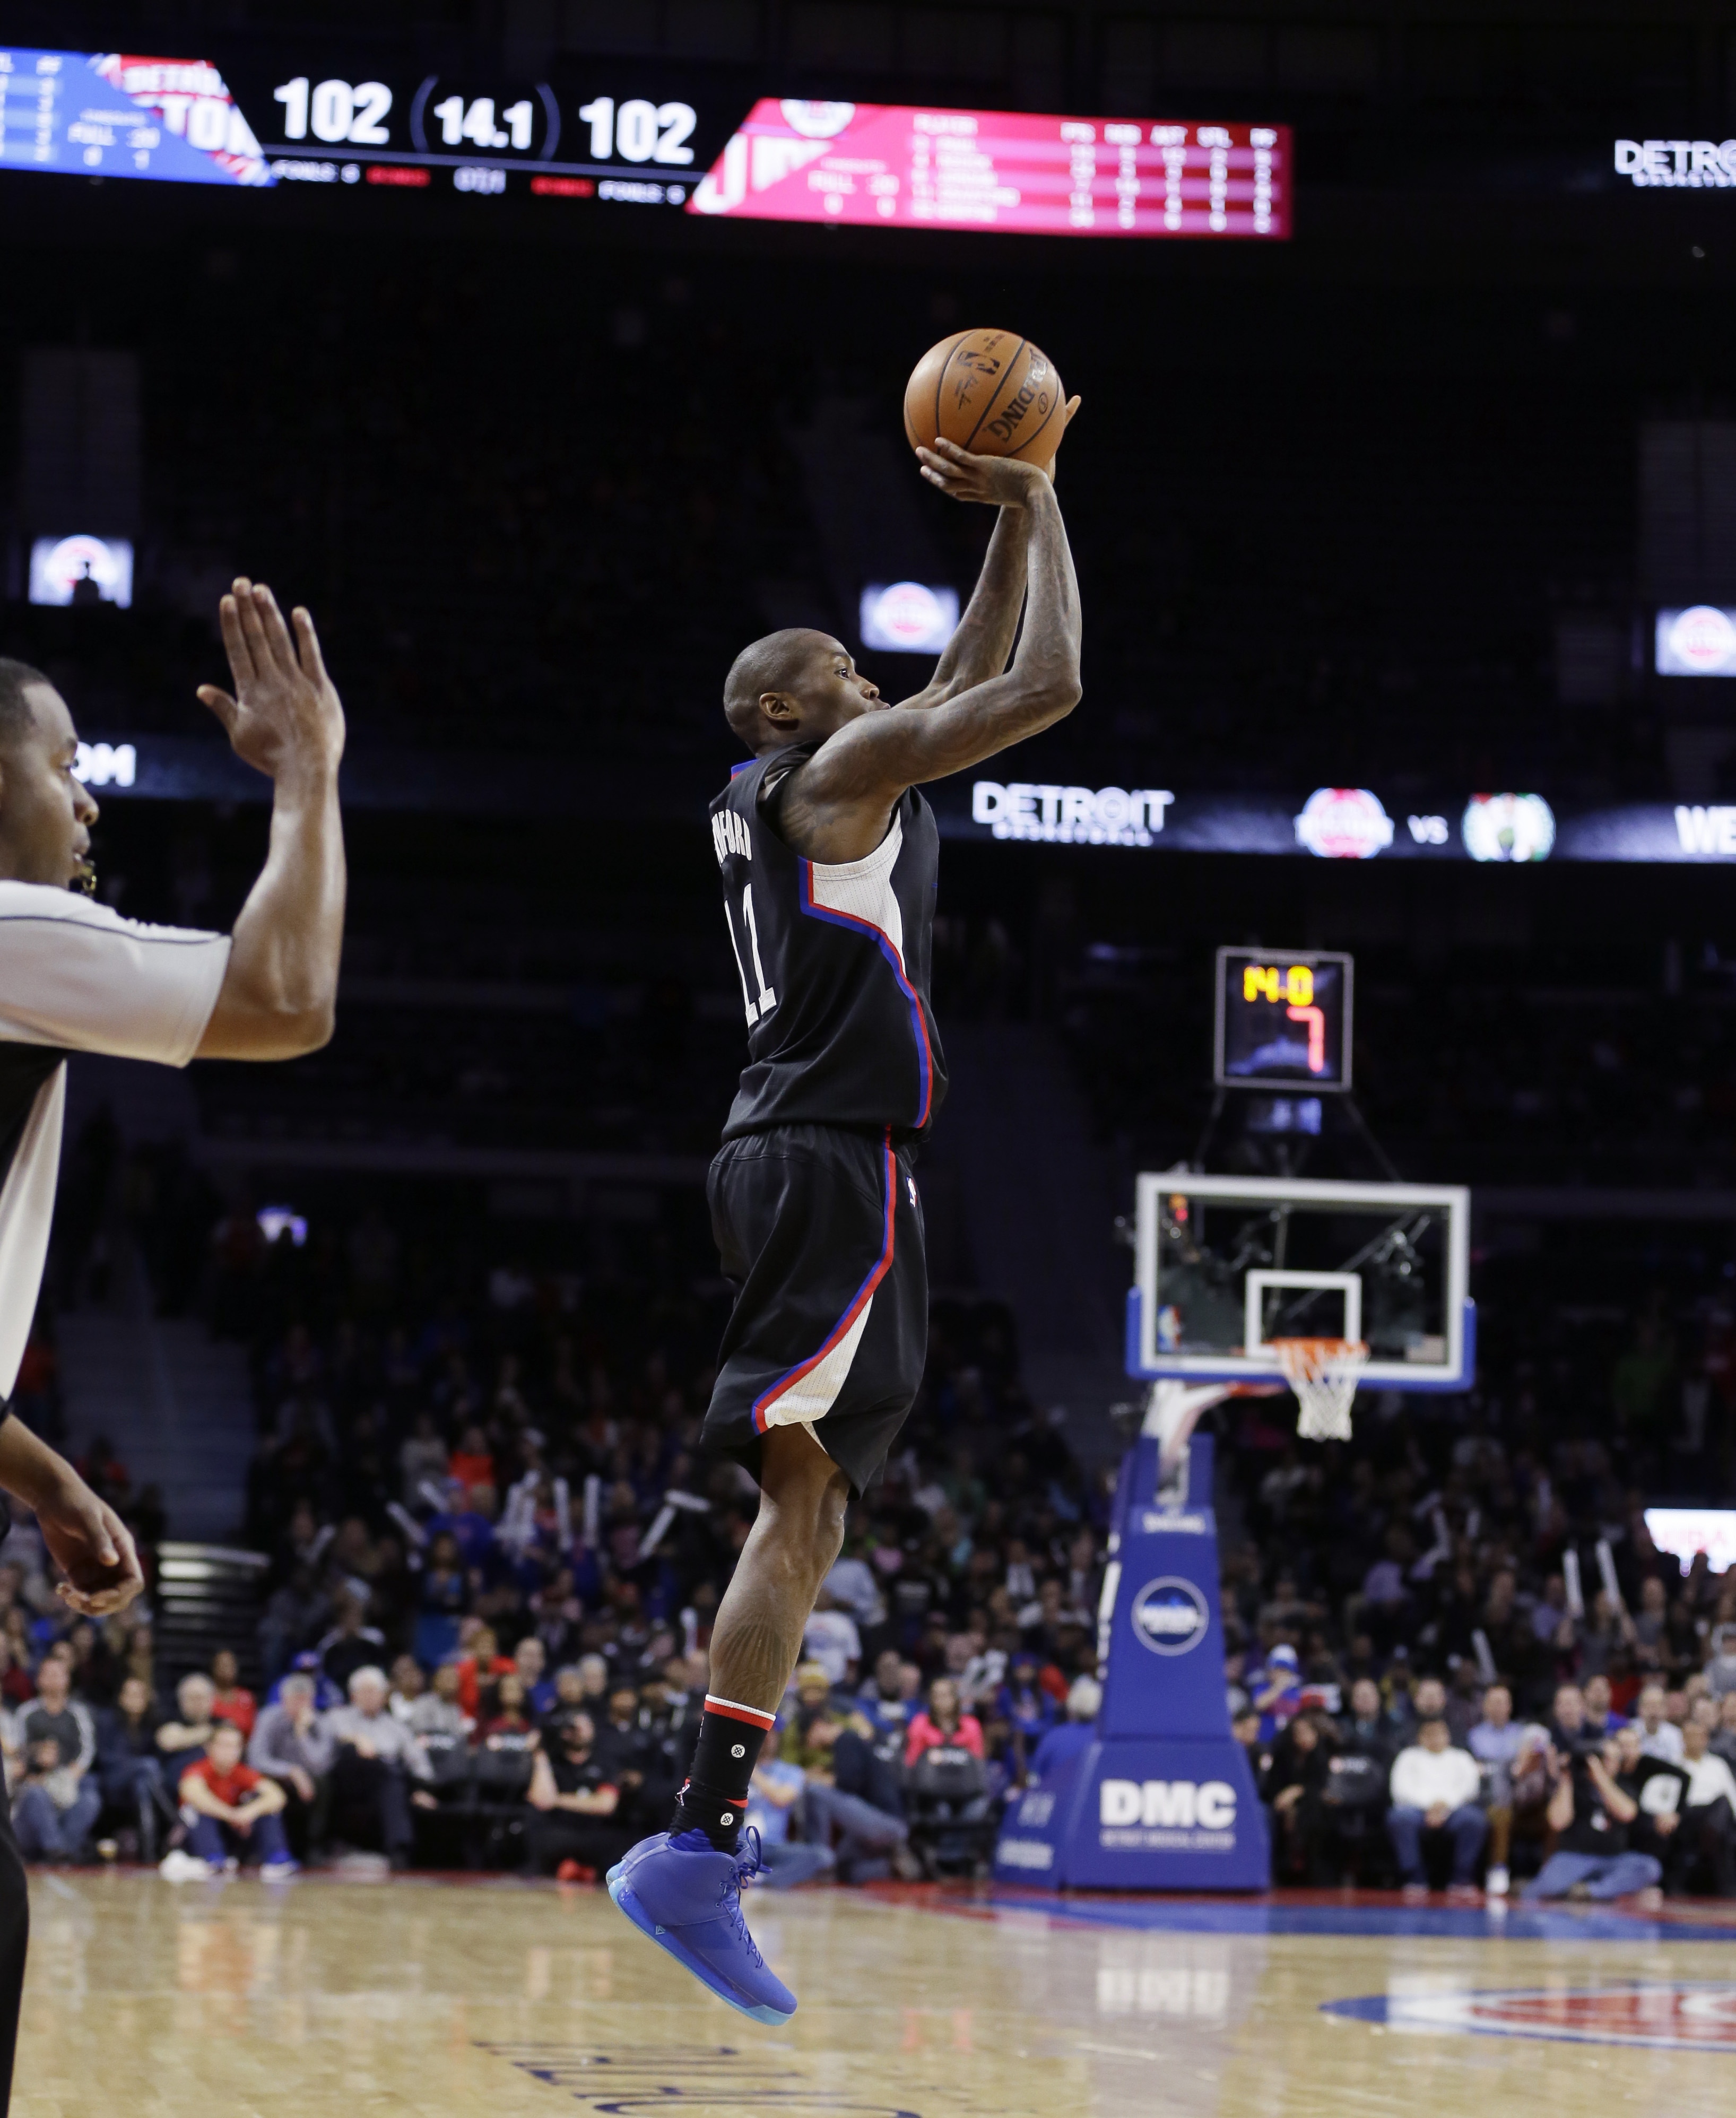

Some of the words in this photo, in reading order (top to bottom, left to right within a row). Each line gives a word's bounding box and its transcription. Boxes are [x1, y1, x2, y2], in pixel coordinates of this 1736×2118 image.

[274, 77, 393, 144] 102
[433, 96, 533, 150] 14.1
[579, 97, 697, 164] 102
[973, 781, 1175, 833] DETROIT
[724, 882, 777, 1028] 11
[1287, 1006, 1324, 1073] 7
[1100, 1779, 1237, 1829] DMC
